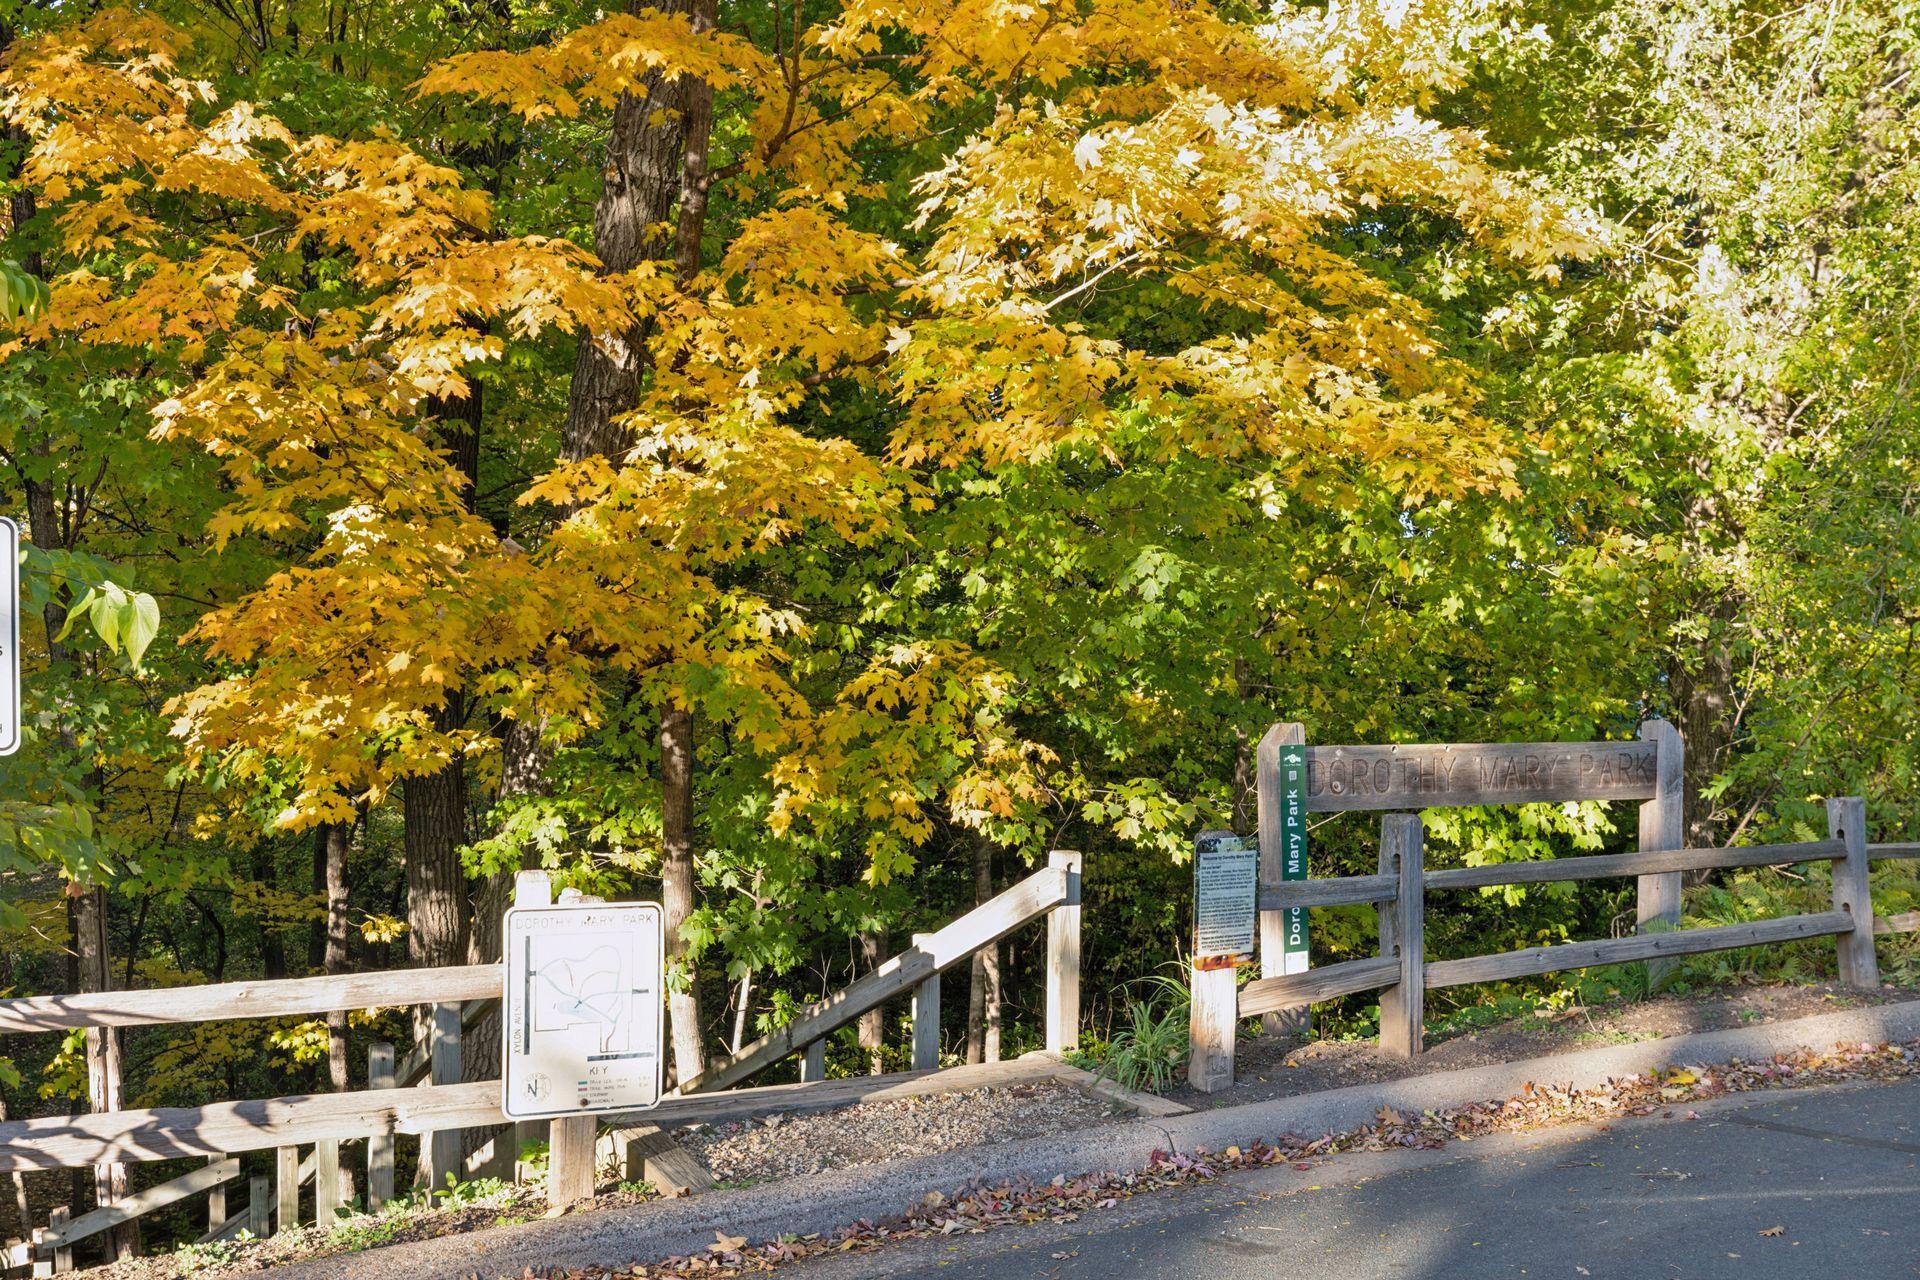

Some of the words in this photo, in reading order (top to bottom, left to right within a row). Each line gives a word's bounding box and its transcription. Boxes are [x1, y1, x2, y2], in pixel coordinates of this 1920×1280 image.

[1307, 757, 1457, 797] DOROTHY
[1478, 754, 1560, 791] MARY
[1578, 752, 1652, 788] PARK
[1287, 789, 1298, 827] Park
[1288, 833, 1301, 873] Mary
[515, 917, 572, 930] DOROTHY
[623, 913, 653, 925] PARK
